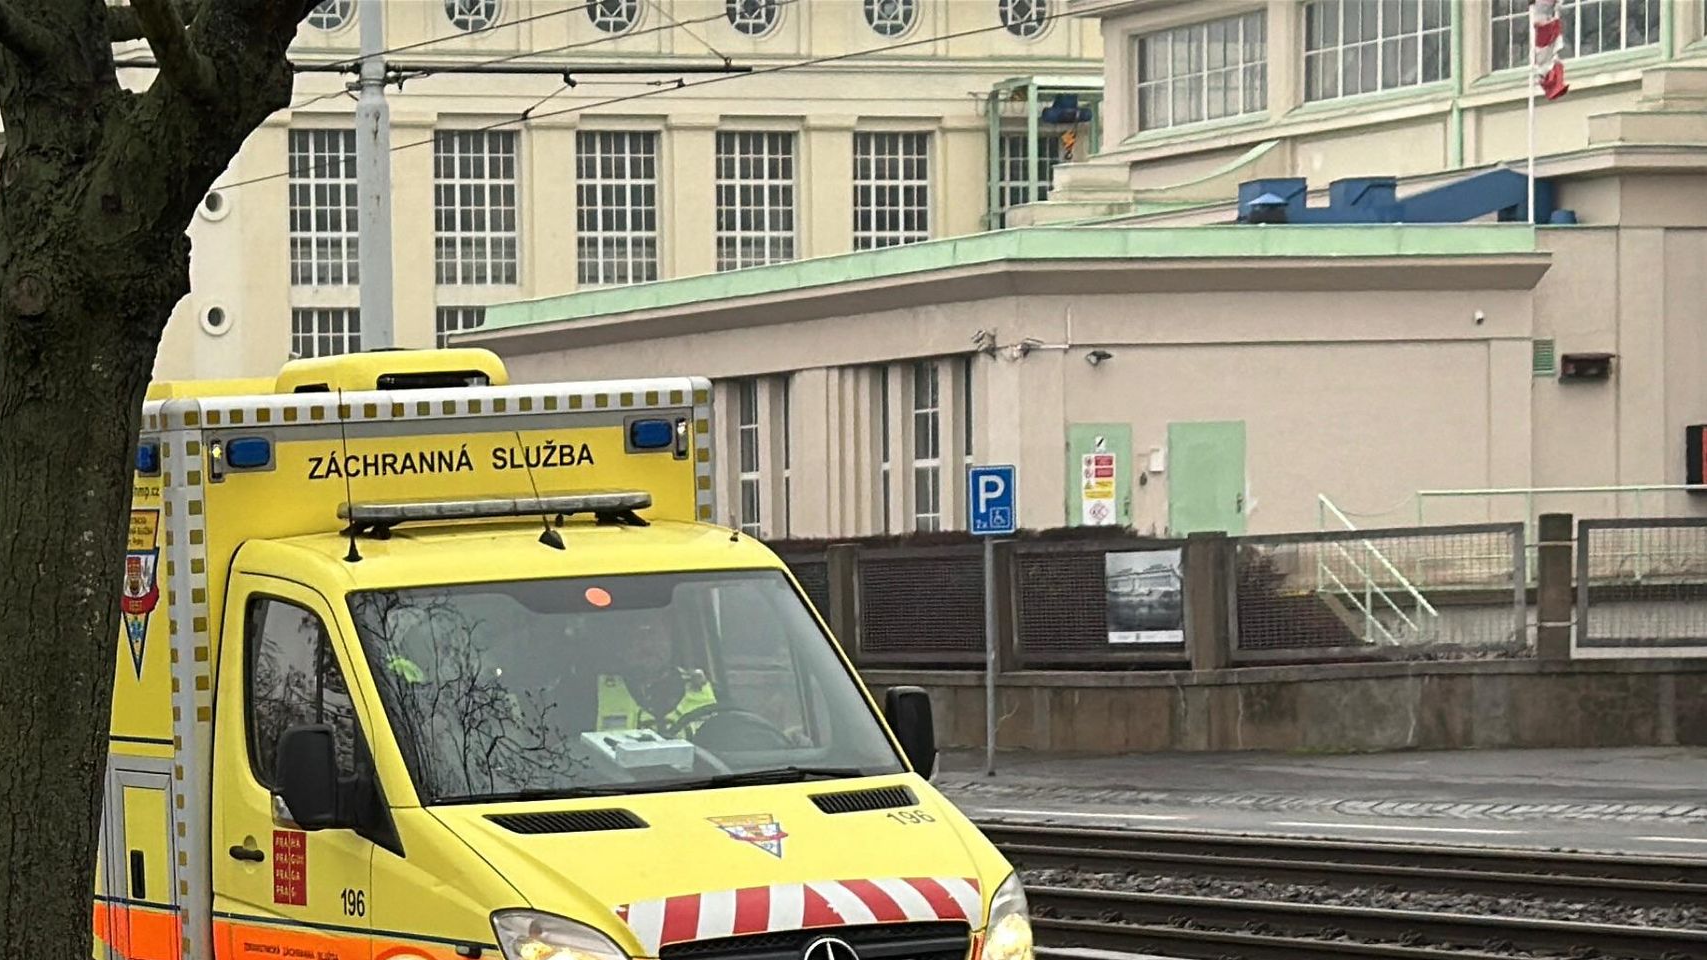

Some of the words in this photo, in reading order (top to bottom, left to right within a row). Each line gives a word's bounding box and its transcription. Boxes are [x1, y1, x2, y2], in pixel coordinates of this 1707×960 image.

[308, 444, 474, 480] ZÁCHRANNÁ
[492, 440, 595, 470] SLUŽBA
[979, 475, 1005, 513] P
[886, 809, 937, 826] 196
[340, 887, 366, 918] 196
